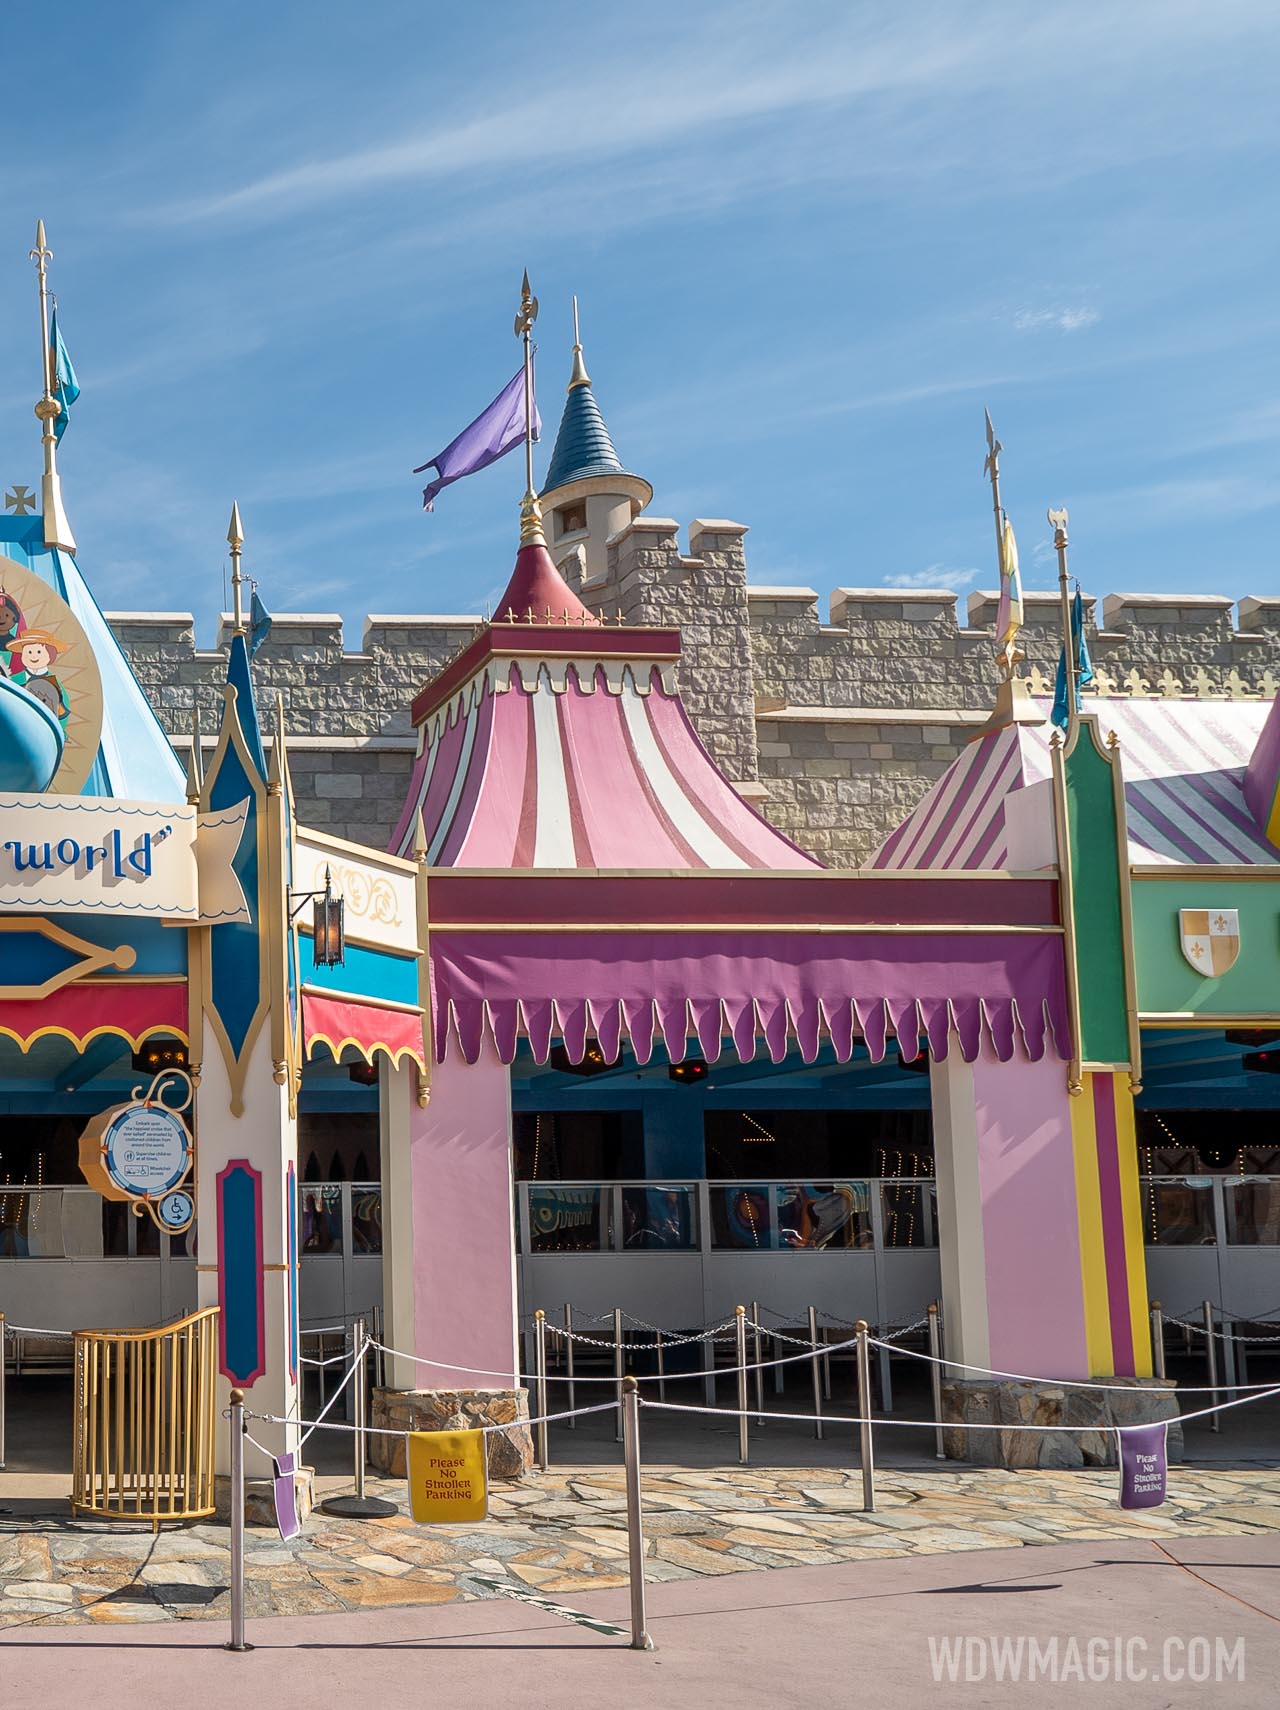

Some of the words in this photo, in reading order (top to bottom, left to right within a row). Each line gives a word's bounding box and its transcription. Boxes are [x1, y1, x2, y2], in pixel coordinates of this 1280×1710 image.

[429, 1458, 465, 1468] Please
[1136, 1454, 1158, 1464] Please
[439, 1469, 457, 1478] No
[425, 1479, 472, 1489] Stroller
[425, 1489, 472, 1500] Parking
